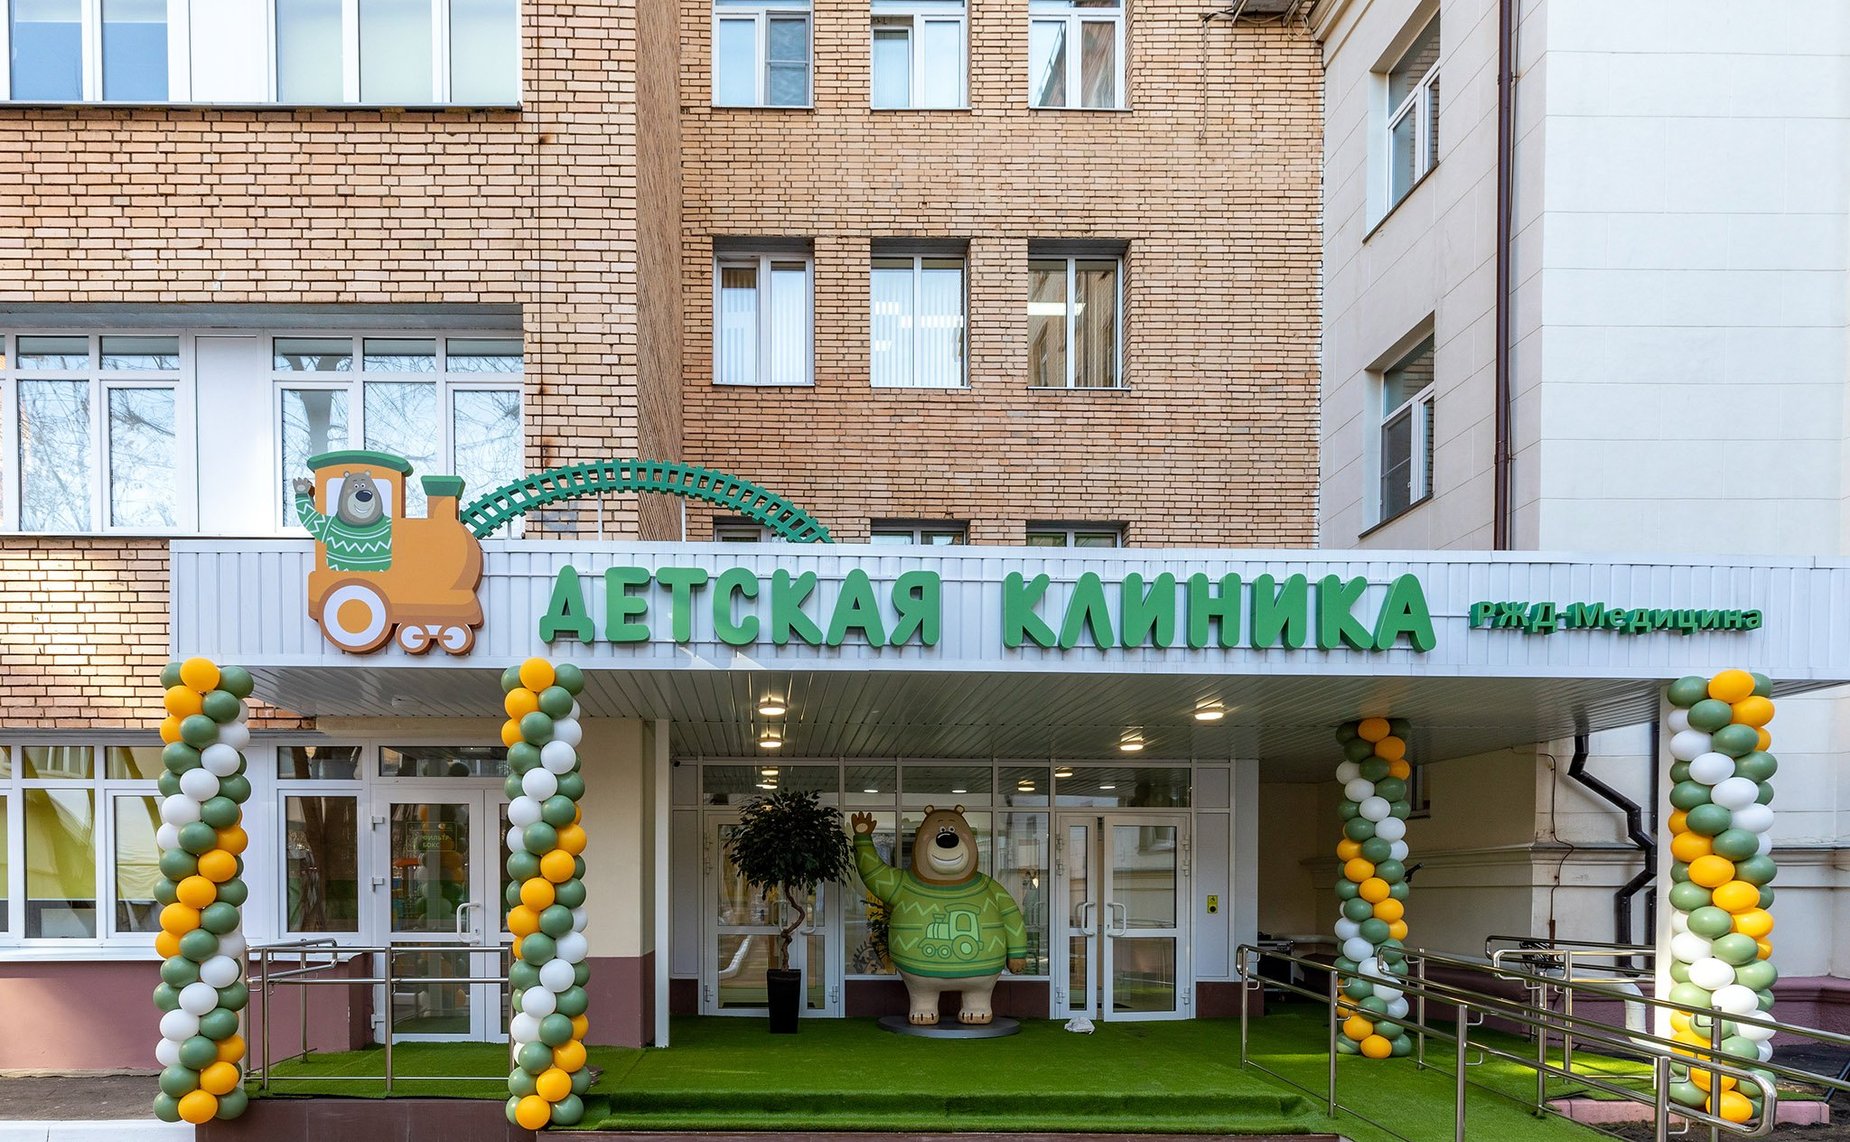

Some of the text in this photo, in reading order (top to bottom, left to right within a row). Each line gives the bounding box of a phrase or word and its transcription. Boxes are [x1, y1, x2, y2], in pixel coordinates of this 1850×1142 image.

[539, 565, 1437, 653] ДЕТСКАЯ КЛИНИКА
[1469, 601, 1763, 635] РЖД-Медицина
